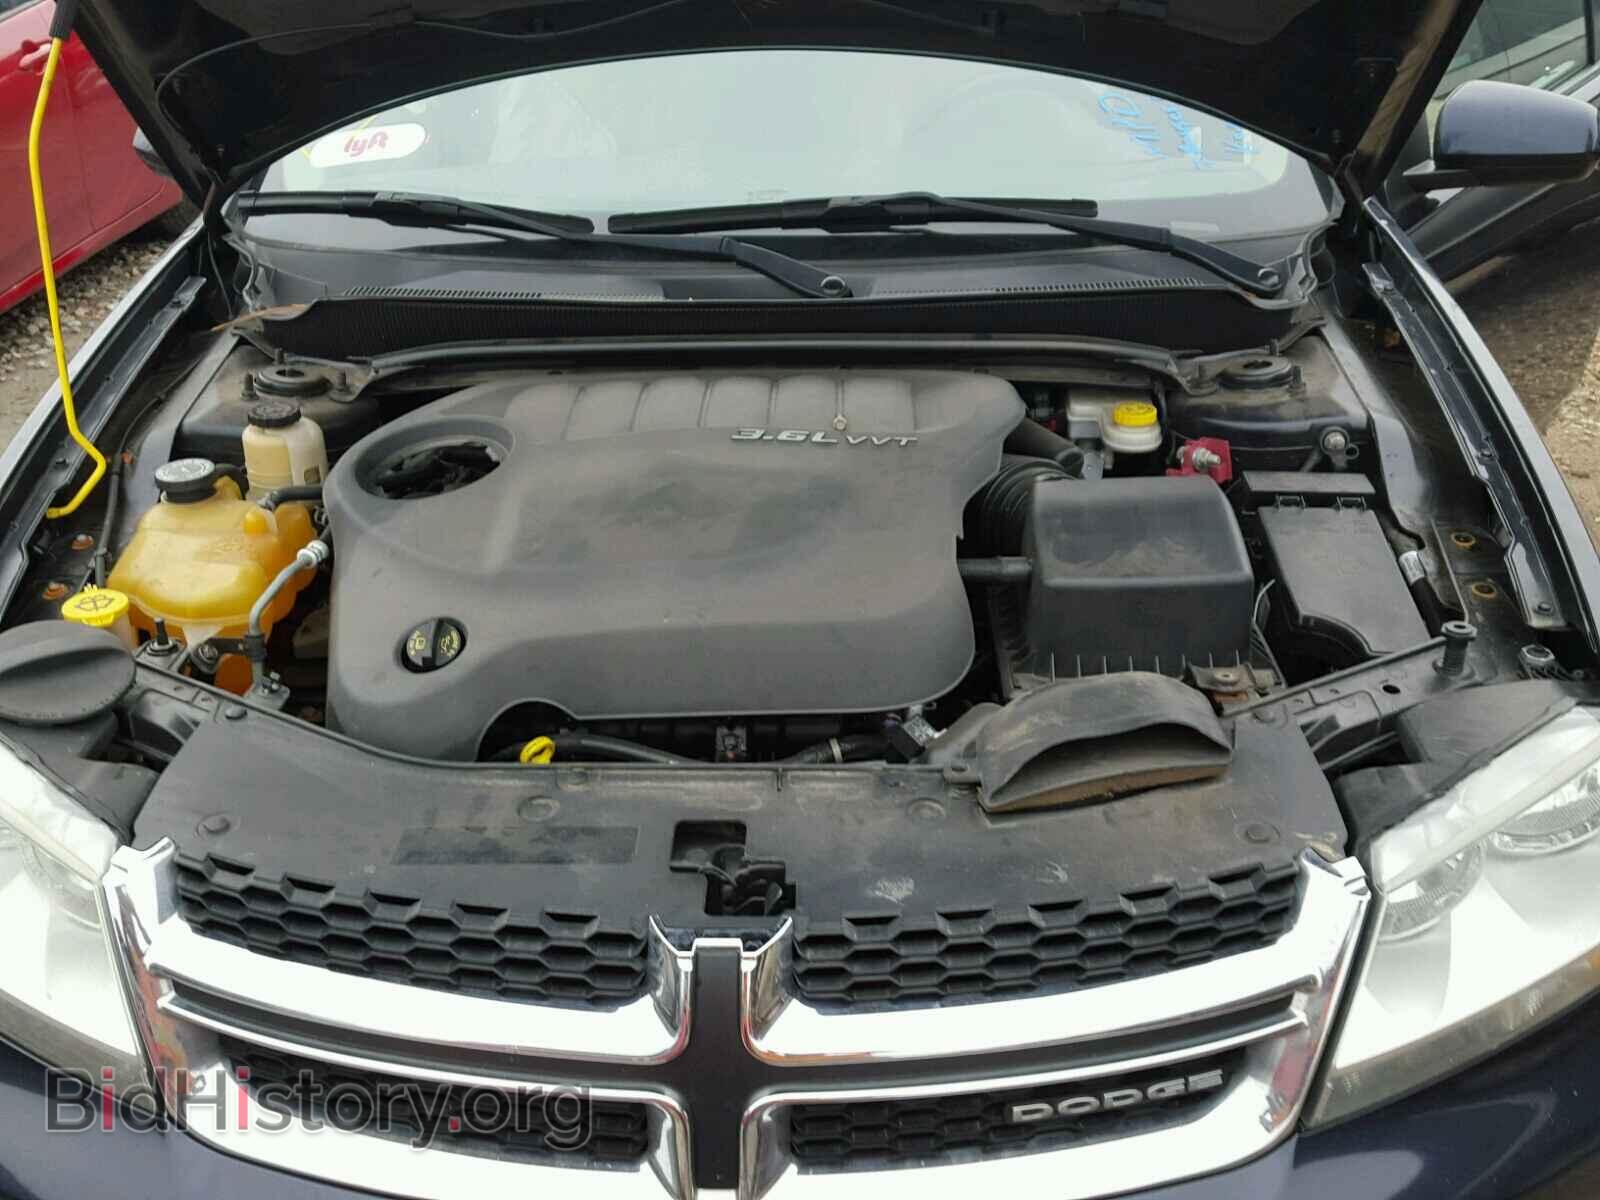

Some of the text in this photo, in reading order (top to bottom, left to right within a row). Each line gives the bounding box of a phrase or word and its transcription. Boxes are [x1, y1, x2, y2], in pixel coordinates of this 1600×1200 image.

[344, 131, 389, 157] lyft
[731, 428, 918, 447] 3.6L VVT
[1011, 1069, 1224, 1123] DODGE
